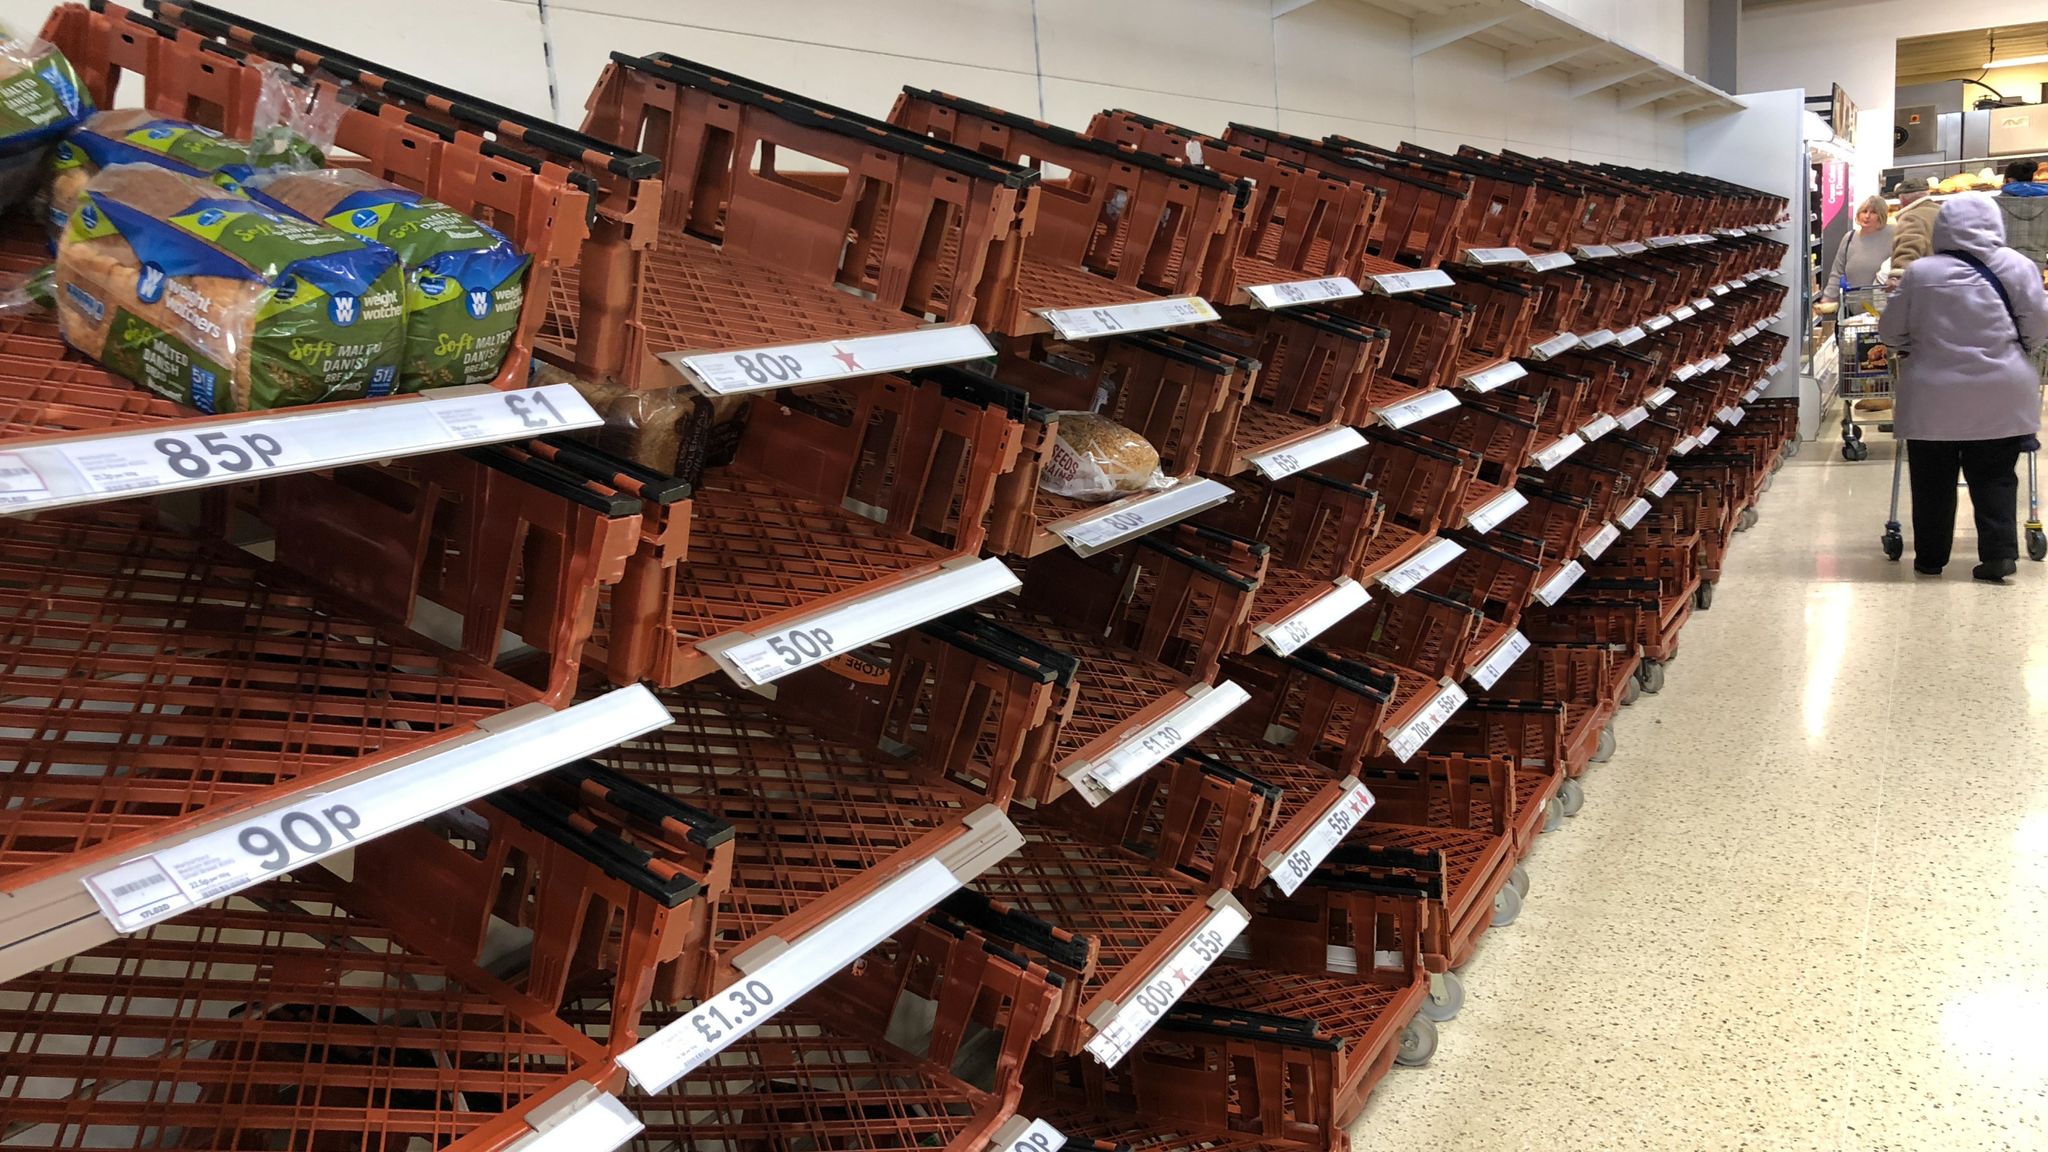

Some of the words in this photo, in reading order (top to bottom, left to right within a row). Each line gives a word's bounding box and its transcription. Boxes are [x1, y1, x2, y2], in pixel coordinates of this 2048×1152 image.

[168, 278, 212, 313] weight
[335, 297, 354, 310] W
[363, 290, 398, 307] weight
[470, 292, 487, 304] W
[495, 283, 522, 300] weig
[495, 295, 523, 313] watch
[166, 298, 221, 338] watchers
[336, 309, 354, 322] W
[362, 304, 402, 321] watche
[472, 303, 488, 316] W
[1092, 309, 1124, 331] £1
[153, 338, 189, 367] MALTED
[288, 338, 335, 366] Soft
[434, 333, 473, 360] Soft
[143, 348, 179, 377] DANISH
[373, 368, 389, 383] 51
[464, 361, 488, 375] BRE
[734, 352, 803, 384] 80p
[324, 371, 354, 384] BRE
[504, 390, 568, 428] £1
[153, 431, 283, 479] 85p
[682, 409, 706, 479] HOLEMEAL
[1044, 462, 1074, 482] AINS
[1051, 443, 1079, 475] SEEDS
[1102, 511, 1145, 532] 80p
[766, 626, 835, 667] 50p
[1142, 725, 1182, 756] £1.30
[237, 803, 361, 872] 90p
[1287, 849, 1313, 879] 85p
[1327, 810, 1352, 836] 55p
[1136, 980, 1175, 1017] 80p
[1189, 929, 1224, 962] 55p
[692, 979, 774, 1043] £1.30
